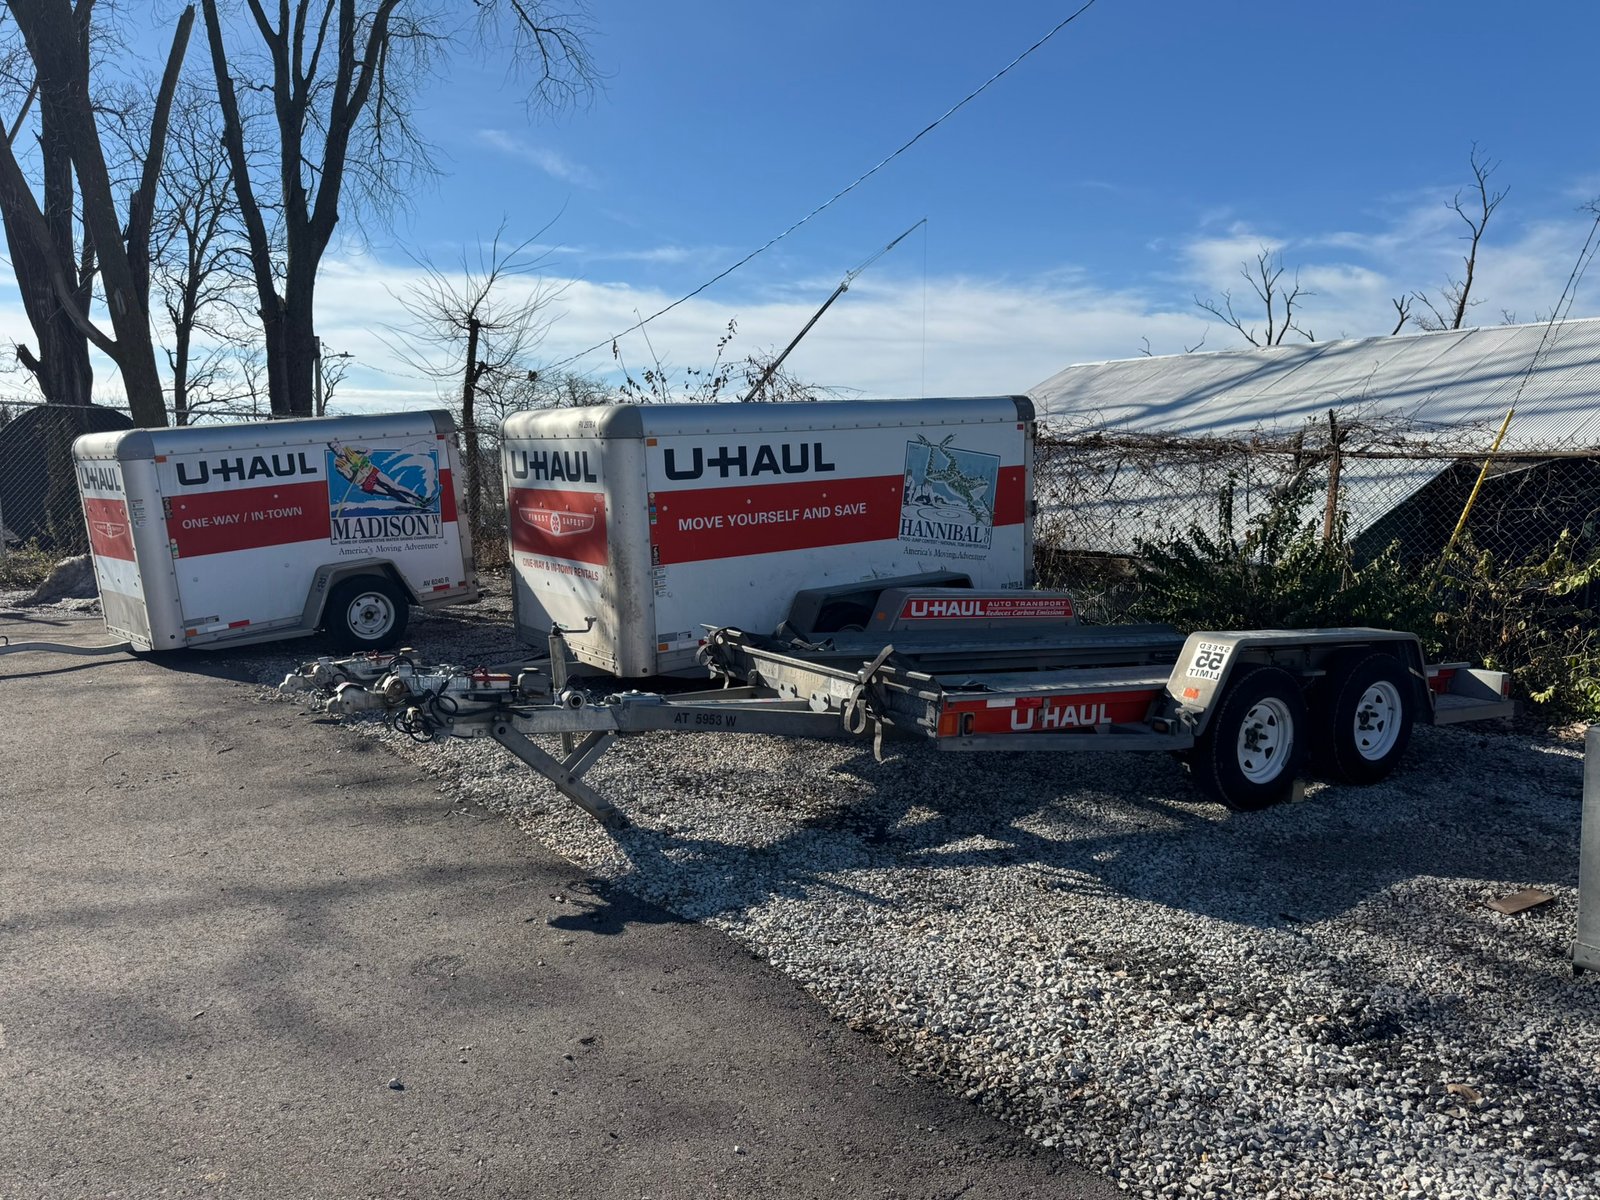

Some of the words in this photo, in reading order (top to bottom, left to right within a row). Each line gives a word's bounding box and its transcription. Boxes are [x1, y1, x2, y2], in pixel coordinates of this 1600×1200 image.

[176, 452, 318, 485] U-HAUL
[511, 451, 597, 483] U-HAUL
[664, 442, 835, 481] U-HAUL
[80, 467, 122, 491] U-HAUL
[182, 513, 240, 530] ONE-WAY
[243, 511, 248, 523] /
[251, 506, 303, 521] IN-TOWN
[333, 514, 430, 540] MADISON
[528, 513, 548, 522] FINEST
[562, 517, 585, 527] SAFEST
[678, 515, 724, 531] MOVE
[727, 508, 800, 527] YOURSELF
[802, 505, 831, 520] AND
[833, 501, 867, 517] SAVE
[900, 518, 984, 543] HANNIBAL
[339, 546, 373, 556] America's
[376, 545, 402, 553] Moving
[404, 543, 439, 551] Adventure
[903, 546, 932, 557] America's
[934, 549, 956, 560] Moving
[957, 551, 987, 561] Adventure
[522, 558, 544, 570] ONE-WAY
[545, 561, 550, 571] &
[551, 562, 573, 575] IN-TOWN
[573, 566, 599, 581] RENTALS
[911, 601, 985, 617] U-HAUL
[985, 609, 1011, 617] Reduces
[674, 713, 690, 724] AT
[696, 713, 722, 726] 5953
[726, 715, 737, 727] W
